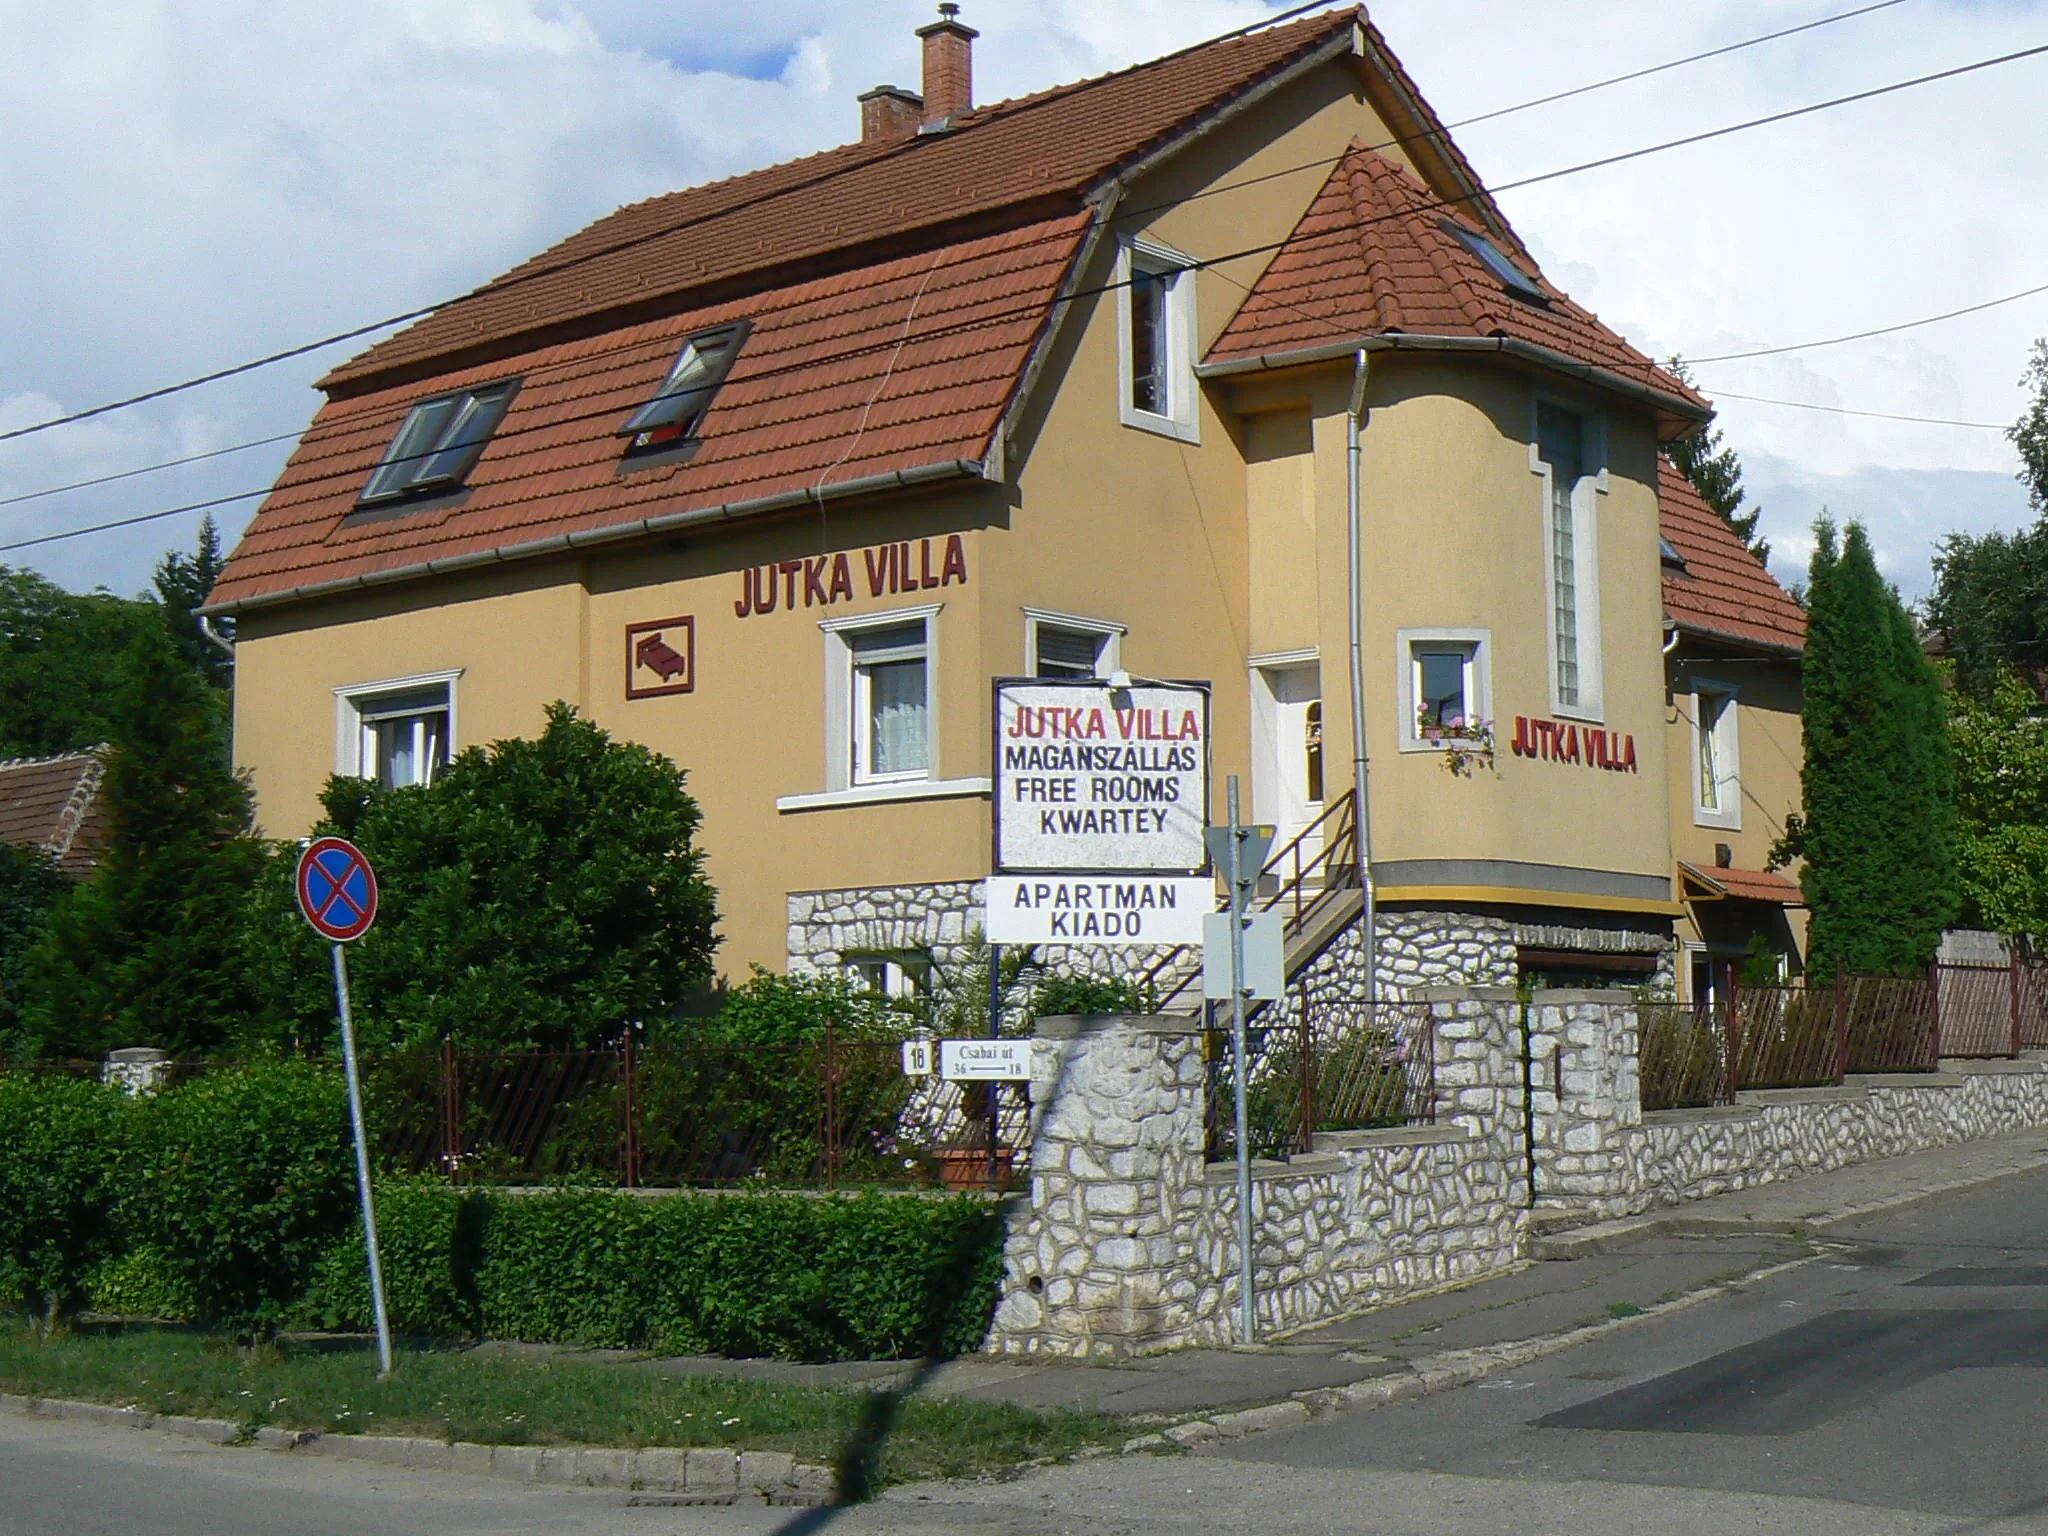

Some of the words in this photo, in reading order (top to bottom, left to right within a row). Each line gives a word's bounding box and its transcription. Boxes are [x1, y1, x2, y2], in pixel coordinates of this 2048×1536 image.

[735, 552, 853, 618] JUTKA
[864, 534, 967, 597] VILLA
[1007, 706, 1106, 739] JUTKA
[1114, 708, 1200, 741] VILLA
[1005, 740, 1196, 772] MAGÁNSZÁLLÁS
[1511, 715, 1580, 766] JUTKA
[1583, 727, 1638, 775] VILLA
[1015, 777, 1077, 802] FREE
[1091, 777, 1180, 802] ROOMS
[1041, 808, 1169, 834] KWARTEY
[1013, 884, 1176, 909] APARTMAN
[1050, 908, 1142, 937] KIADÓ
[910, 1048, 925, 1069] 18
[960, 1046, 997, 1059] Csabai
[953, 1063, 967, 1075] 36
[1010, 1063, 1022, 1075] 18
